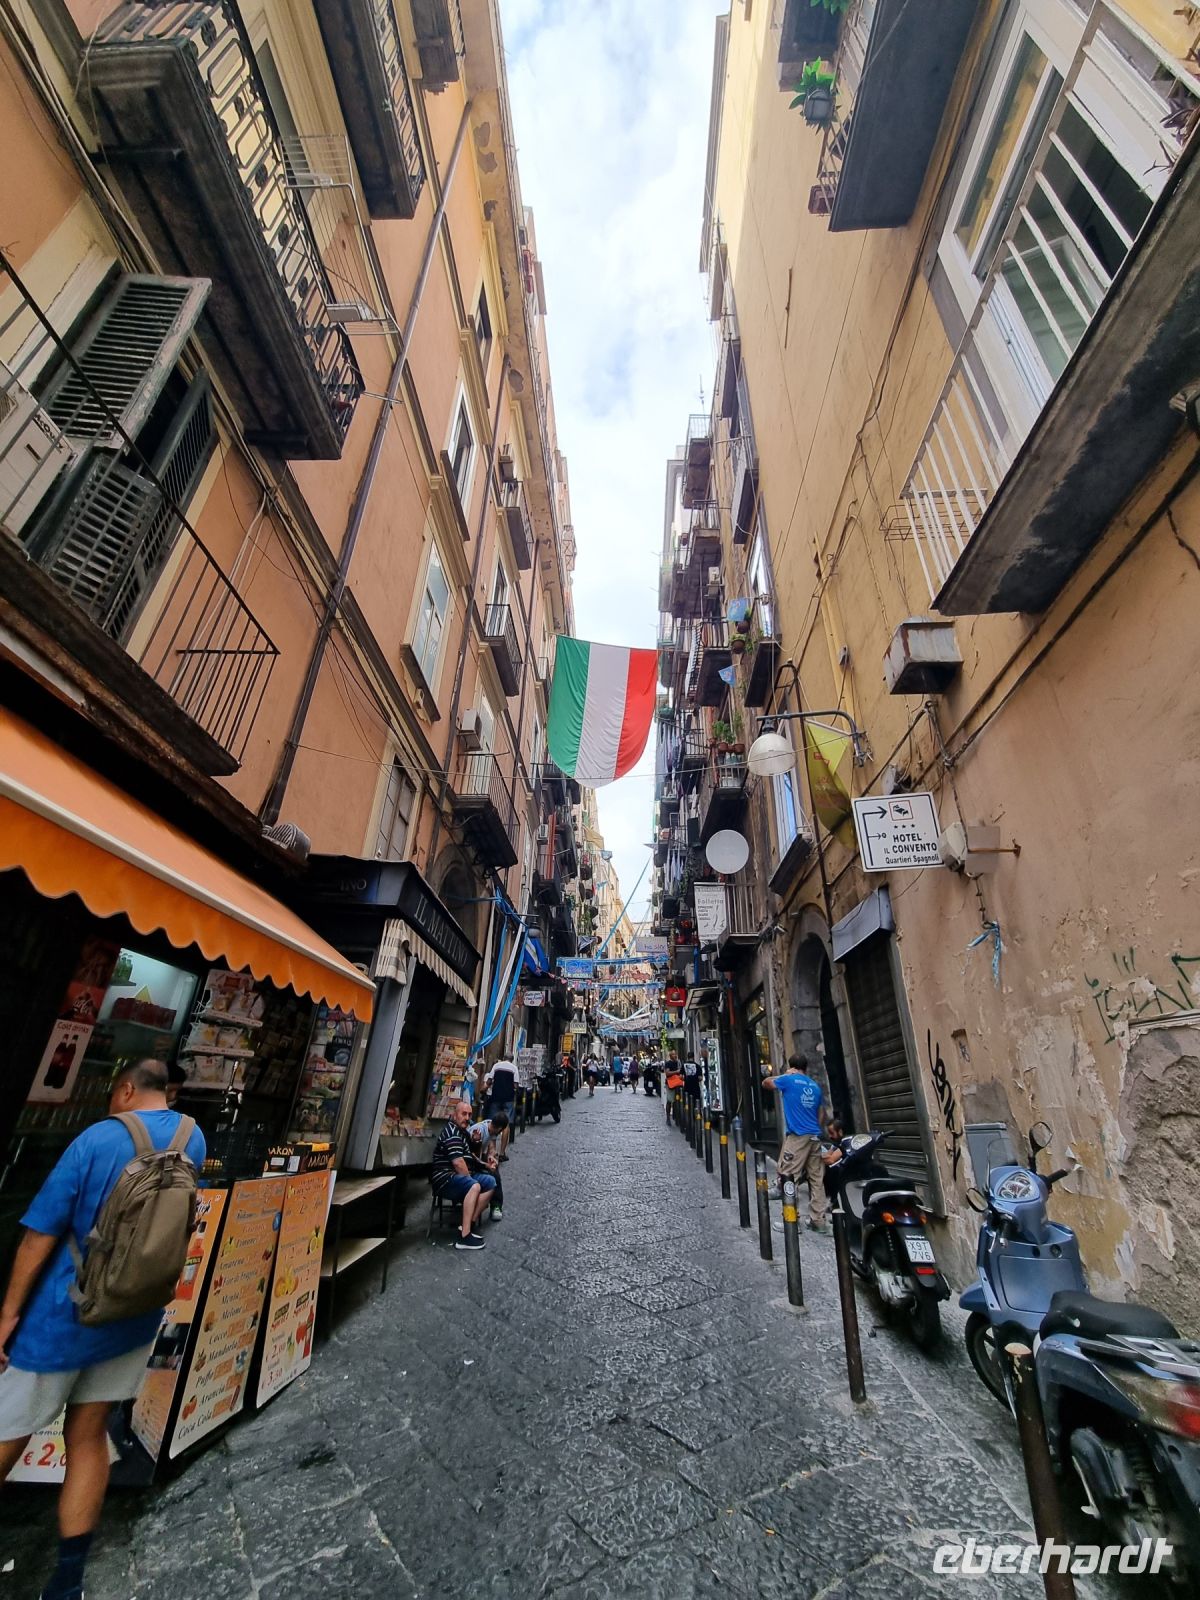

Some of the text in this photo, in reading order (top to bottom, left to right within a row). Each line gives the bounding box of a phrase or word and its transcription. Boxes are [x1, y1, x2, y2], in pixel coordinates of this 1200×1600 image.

[893, 833, 922, 843] HOTEL
[892, 842, 937, 854] CONVENTO
[885, 854, 939, 864] Quartieri Spagnoli
[414, 893, 428, 927] IL
[57, 1022, 89, 1033] Cold drinks
[910, 1241, 929, 1250] X9T
[37, 1442, 67, 1468] 2,0
